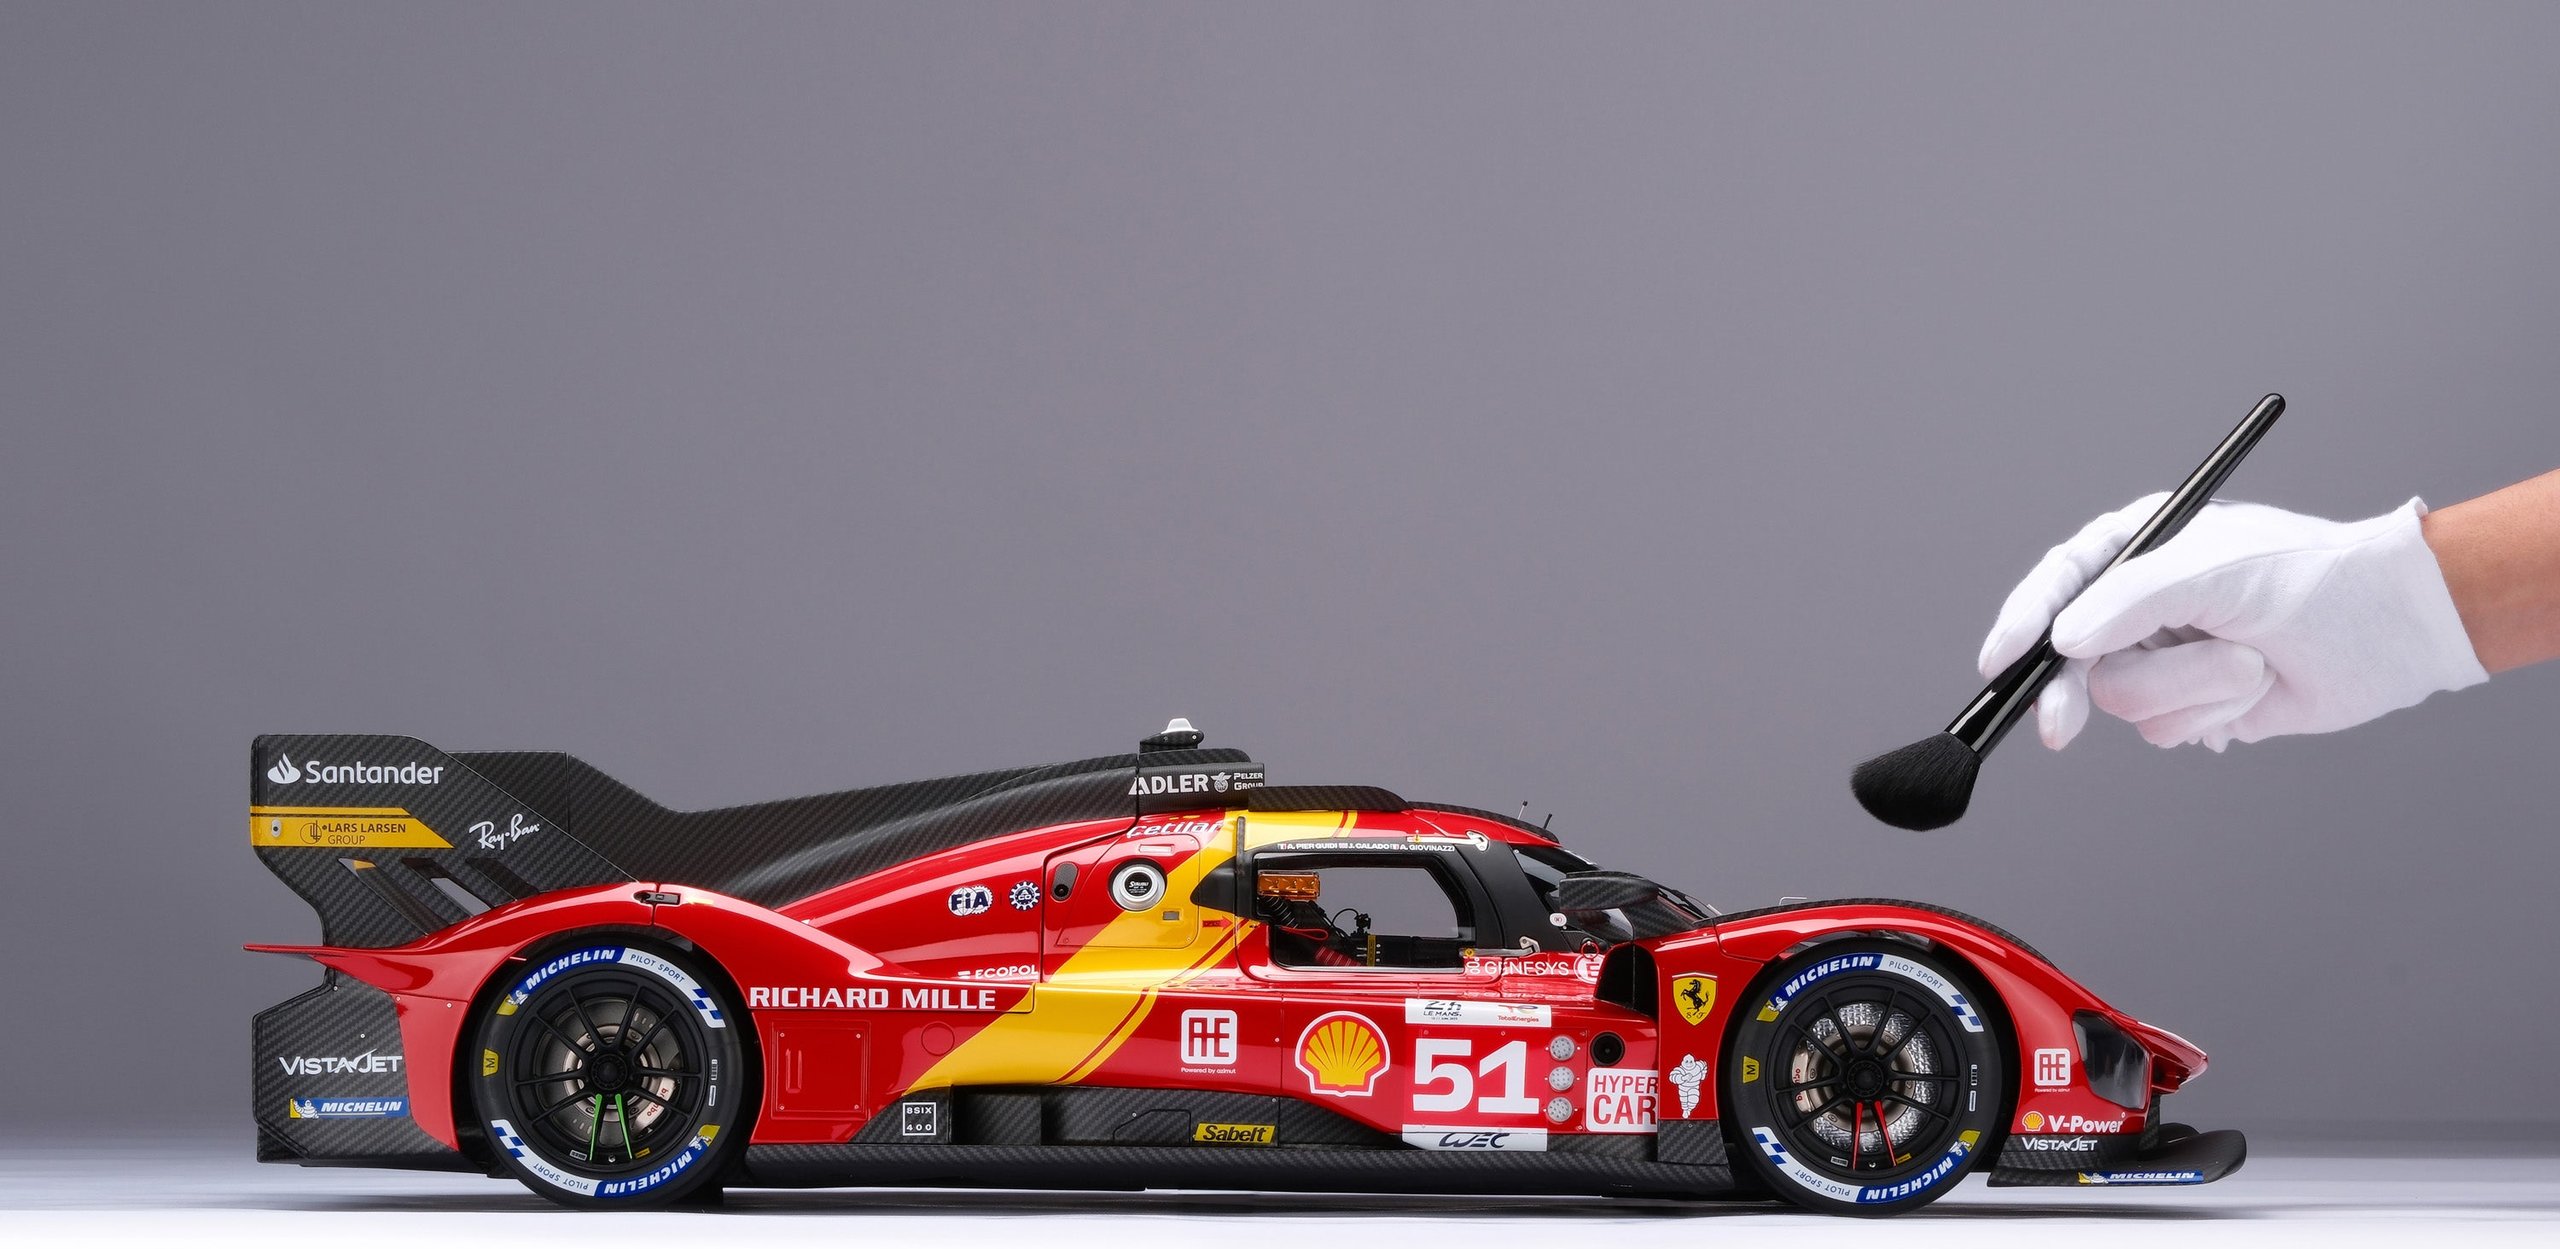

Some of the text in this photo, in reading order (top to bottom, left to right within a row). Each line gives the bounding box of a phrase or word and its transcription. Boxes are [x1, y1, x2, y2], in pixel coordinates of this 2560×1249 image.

[305, 760, 444, 785] Santander
[1128, 774, 1209, 795] ADLER
[328, 823, 406, 833] LARS LARSEN
[328, 834, 366, 845] GROUP
[526, 949, 616, 990] MICHELIN
[630, 953, 686, 983] PILOT SPORT
[975, 965, 1038, 979] ECOPOL
[1785, 956, 1874, 998] MICHELIN
[1889, 960, 1944, 990] PILOT SPORT
[750, 987, 996, 1009] RICHARD MILLE
[1412, 1038, 1540, 1114] 51
[1746, 1063, 1756, 1075] M
[1594, 1075, 1658, 1094] HYPER
[321, 1101, 402, 1112] MICHELIN
[906, 1106, 932, 1114] 8SIX
[1593, 1094, 1657, 1125] CAR
[906, 1123, 932, 1131] 400
[1203, 1125, 1266, 1142] Sabelt
[2048, 1115, 2124, 1133] V-Power
[1438, 1132, 1510, 1148] WEC
[533, 1163, 589, 1191] PILOT SPORT
[604, 1151, 693, 1194] MICHELIN
[1794, 1169, 1851, 1197] PILOT SPORT
[1865, 1157, 1953, 1201] MICHELIN
